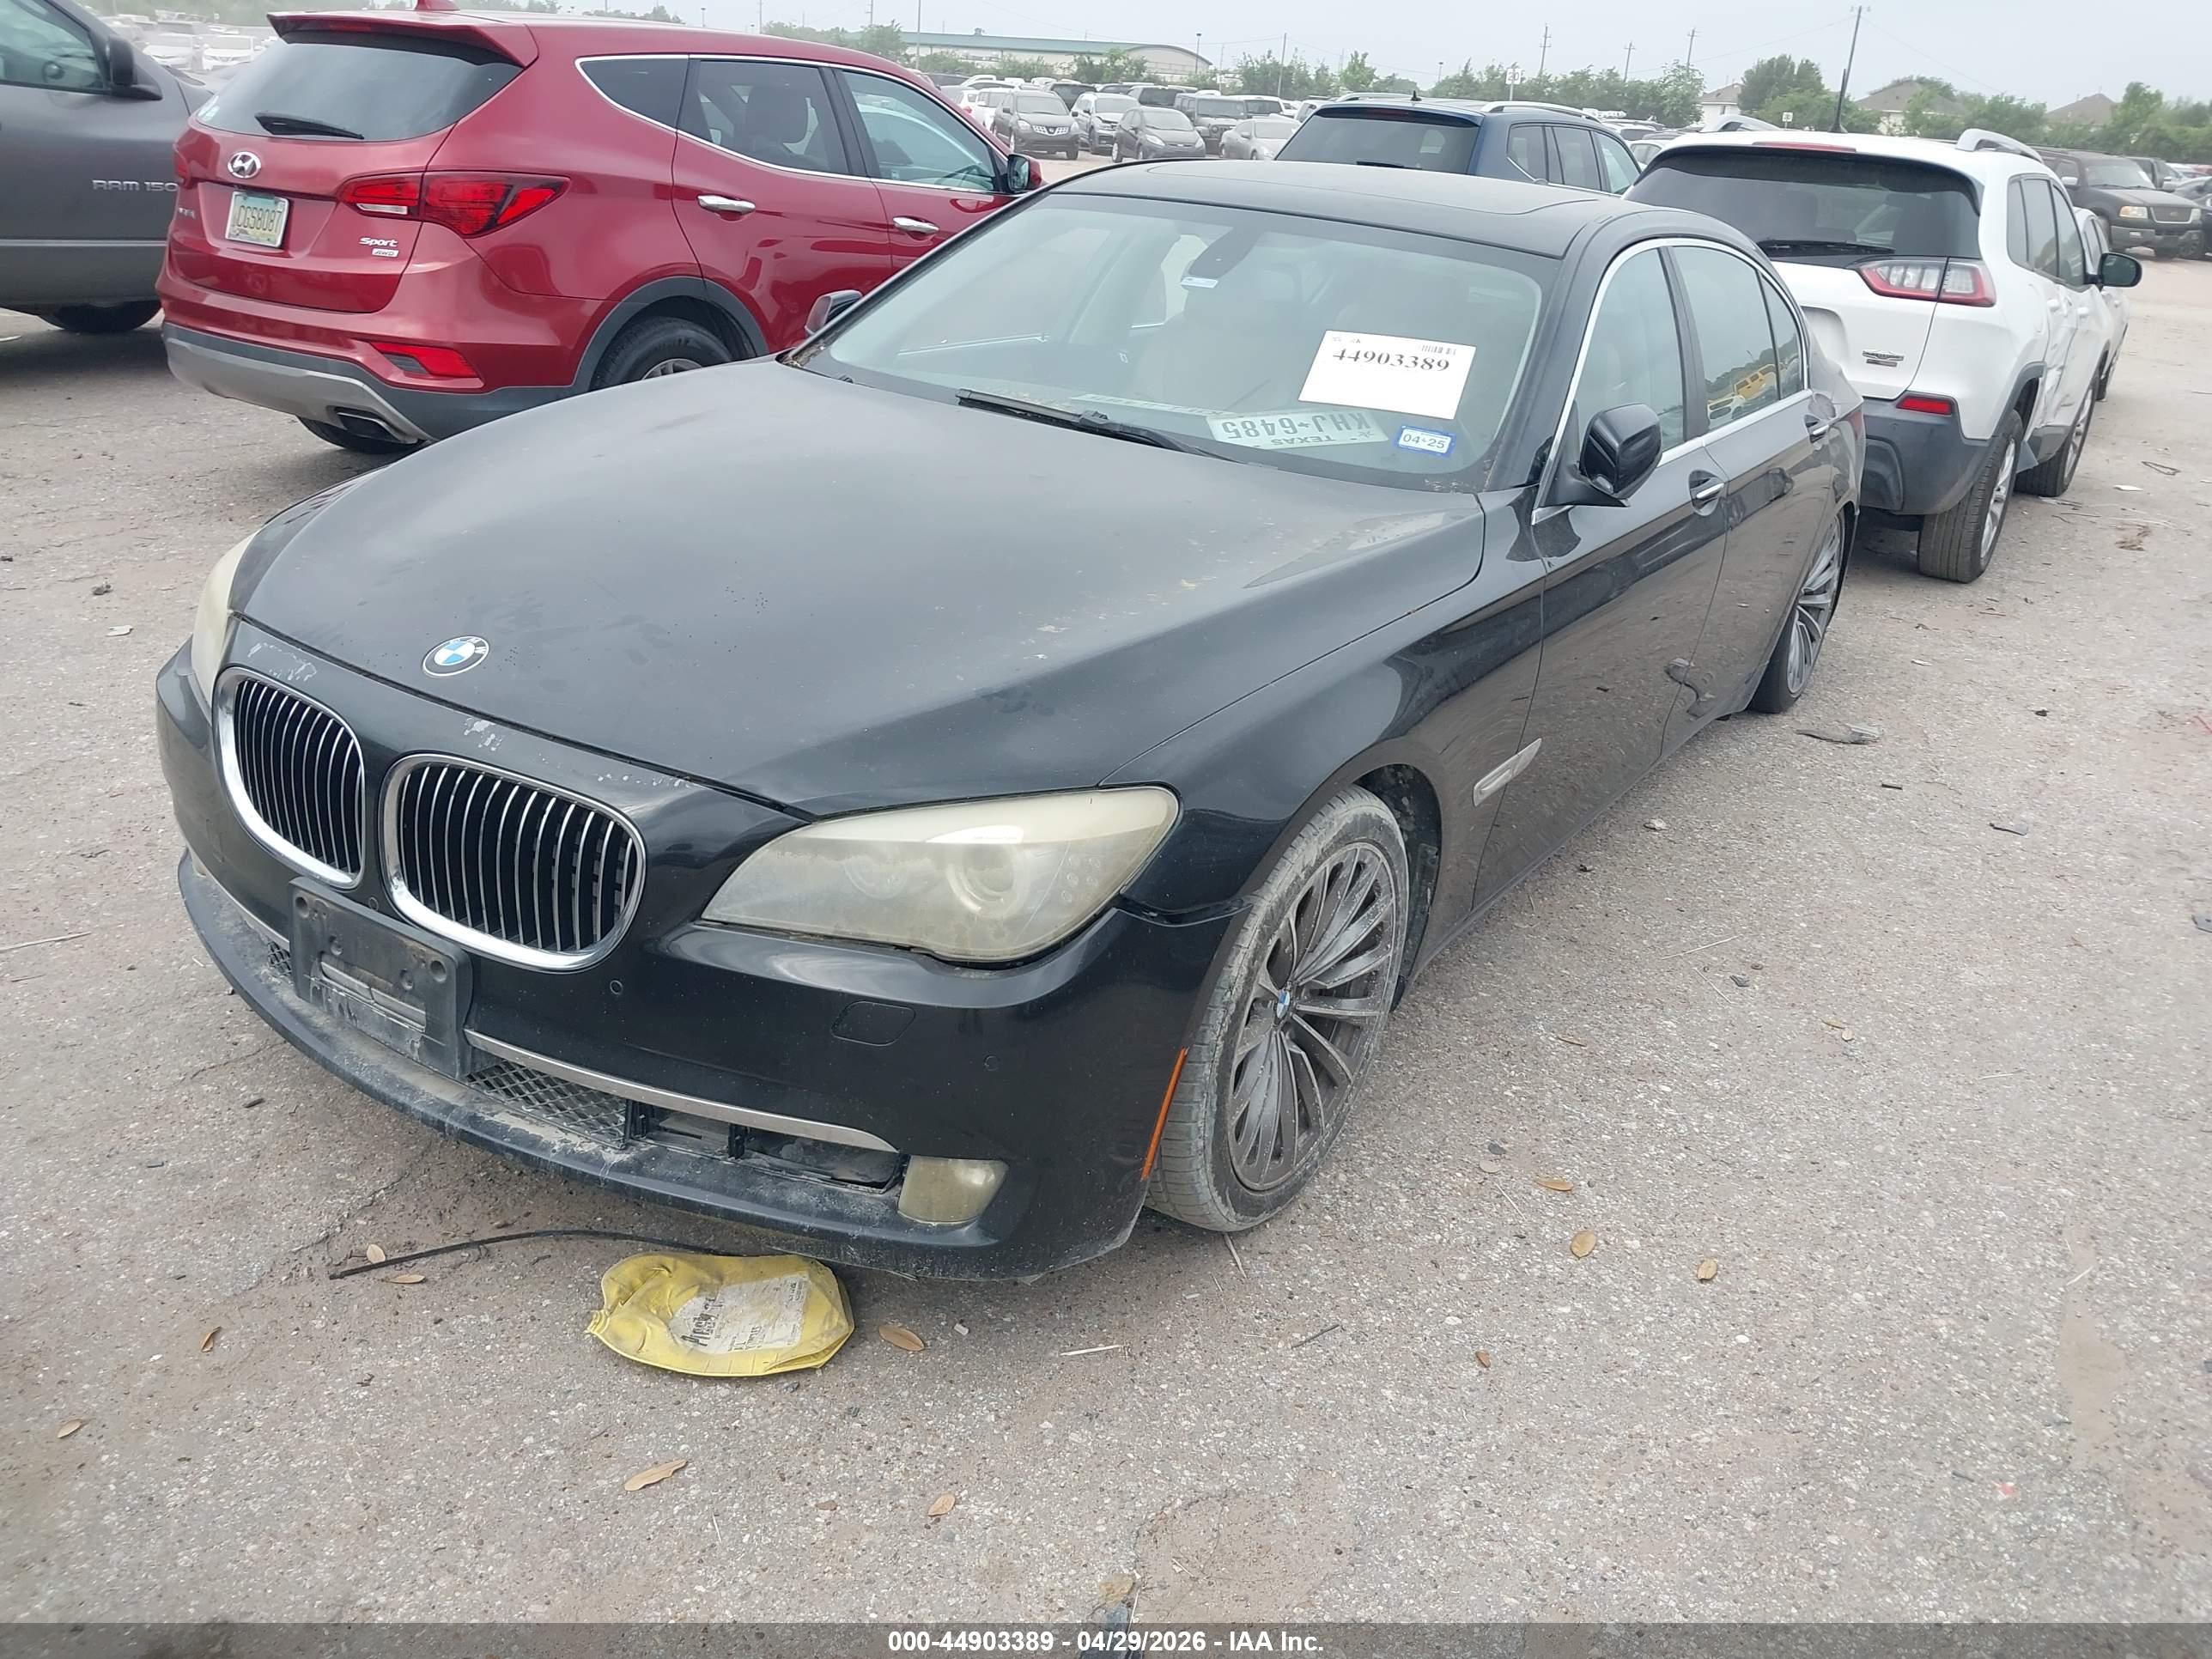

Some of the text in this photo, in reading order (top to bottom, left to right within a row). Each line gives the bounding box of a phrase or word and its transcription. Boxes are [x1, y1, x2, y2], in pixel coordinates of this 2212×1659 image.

[91, 179, 140, 191] RAM
[358, 236, 398, 247] Sport
[1332, 347, 1450, 372] 44903389
[1270, 435, 1338, 446] TEXAS
